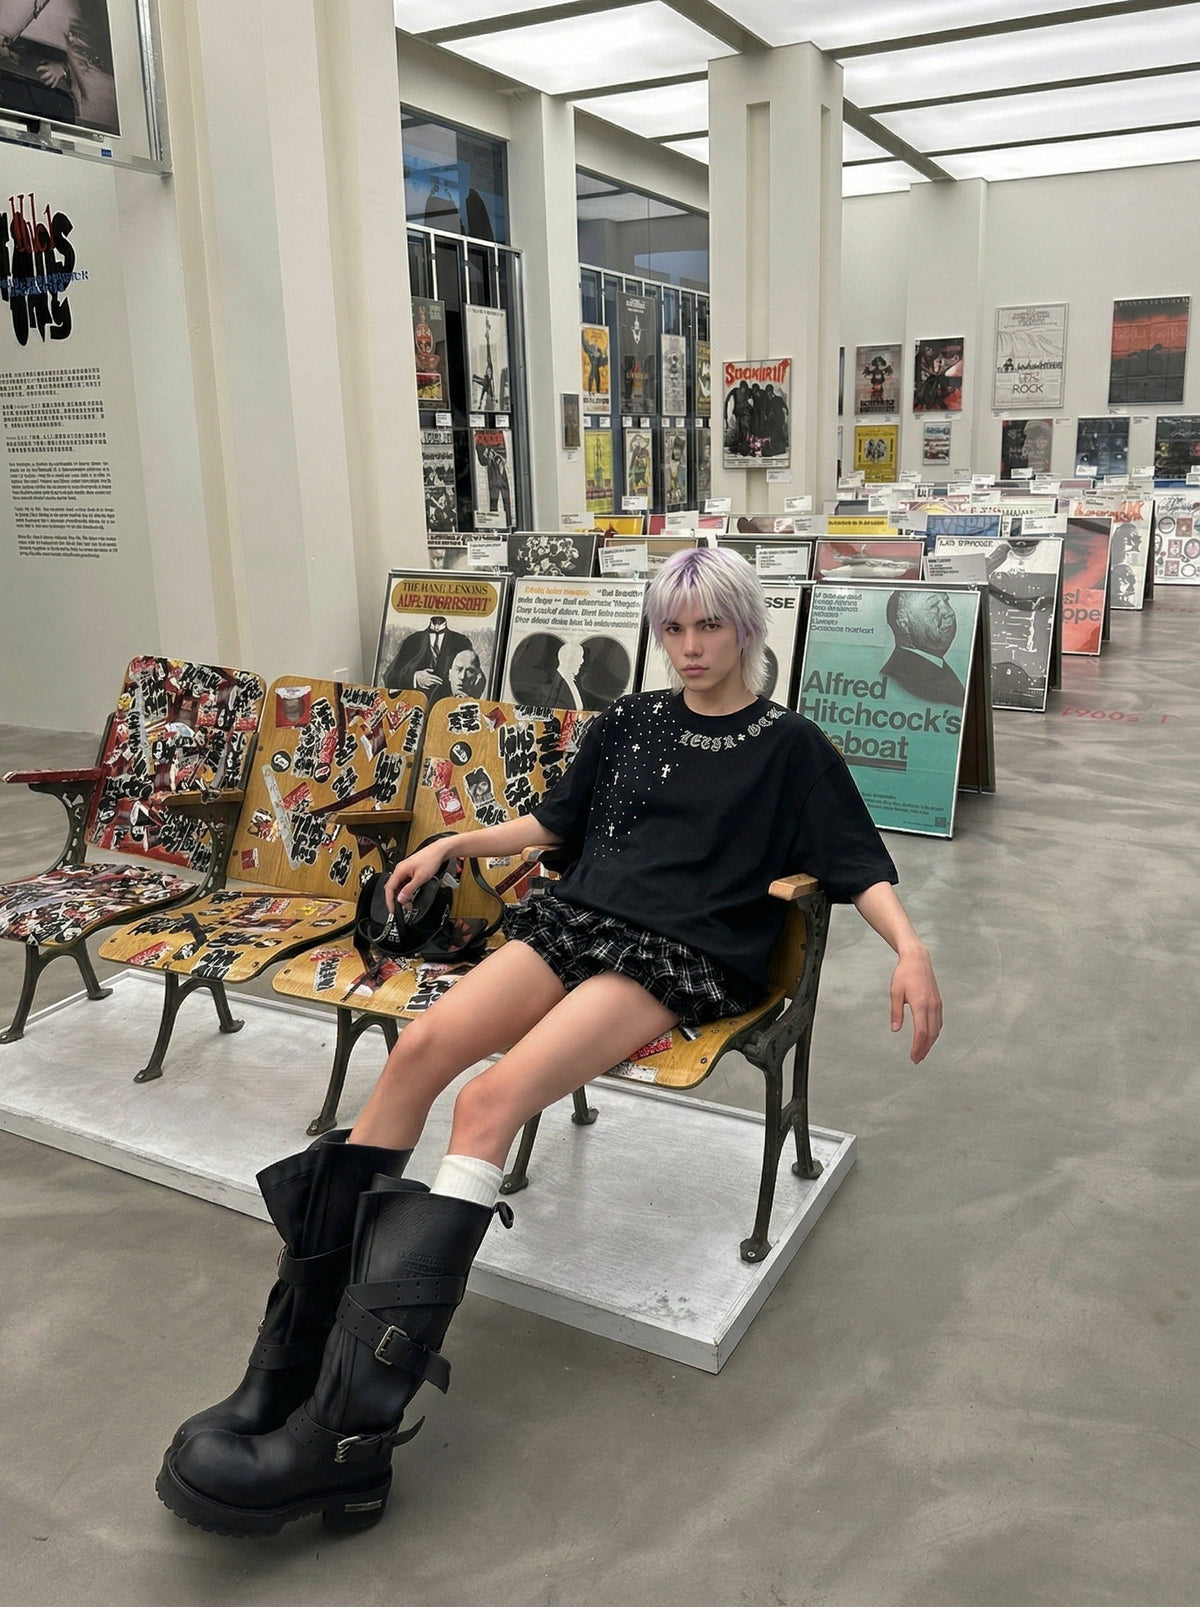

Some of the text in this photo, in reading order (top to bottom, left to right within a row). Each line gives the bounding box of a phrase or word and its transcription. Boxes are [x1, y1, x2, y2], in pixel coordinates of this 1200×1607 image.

[1012, 384, 1044, 394] ROCK
[403, 582, 420, 592] THE
[803, 670, 888, 700] Alfred
[801, 697, 962, 735] Hitchcock's
[824, 730, 909, 759] eboat
